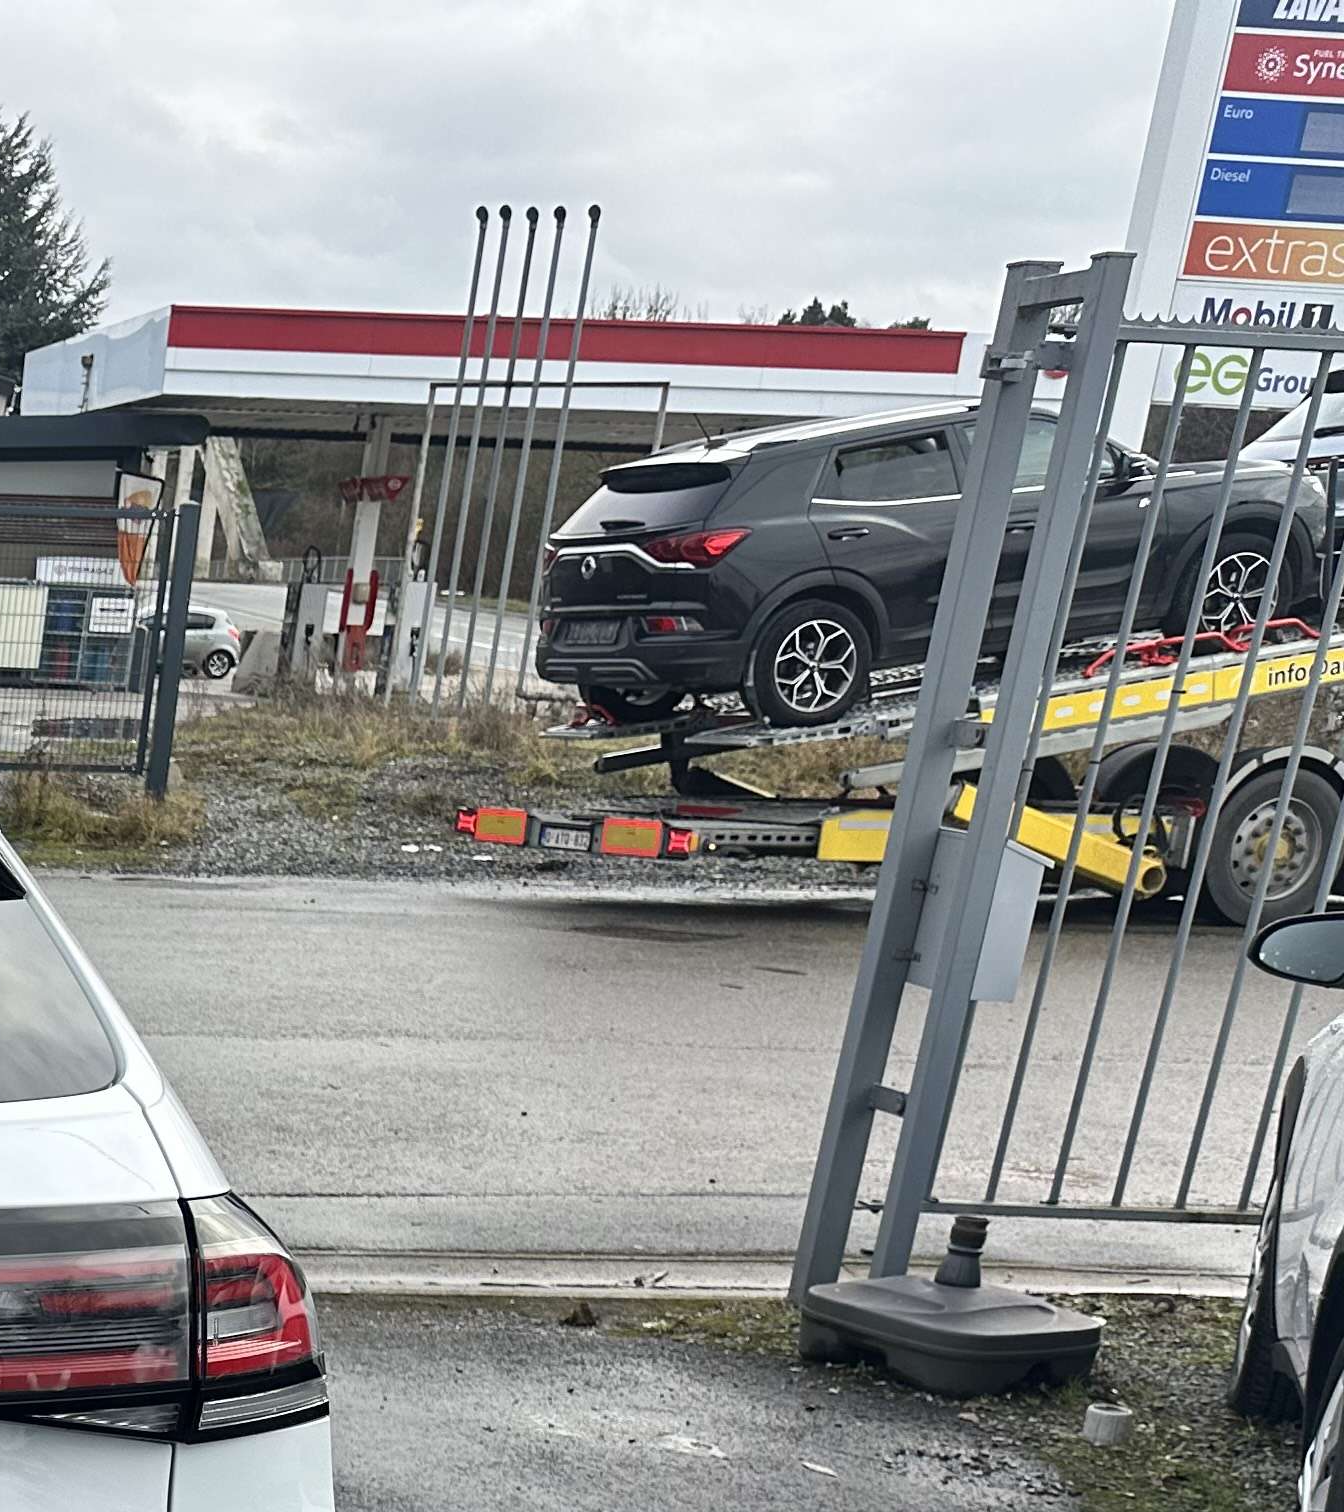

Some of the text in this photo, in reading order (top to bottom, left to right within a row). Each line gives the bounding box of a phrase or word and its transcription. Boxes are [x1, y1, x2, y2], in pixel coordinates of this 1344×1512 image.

[1313, 48, 1334, 58] FUEL
[1223, 104, 1254, 119] Euro
[1210, 167, 1251, 183] Diesel
[1204, 229, 1344, 278] extras
[1200, 297, 1297, 328] Mobil
[1255, 367, 1318, 394] Grou
